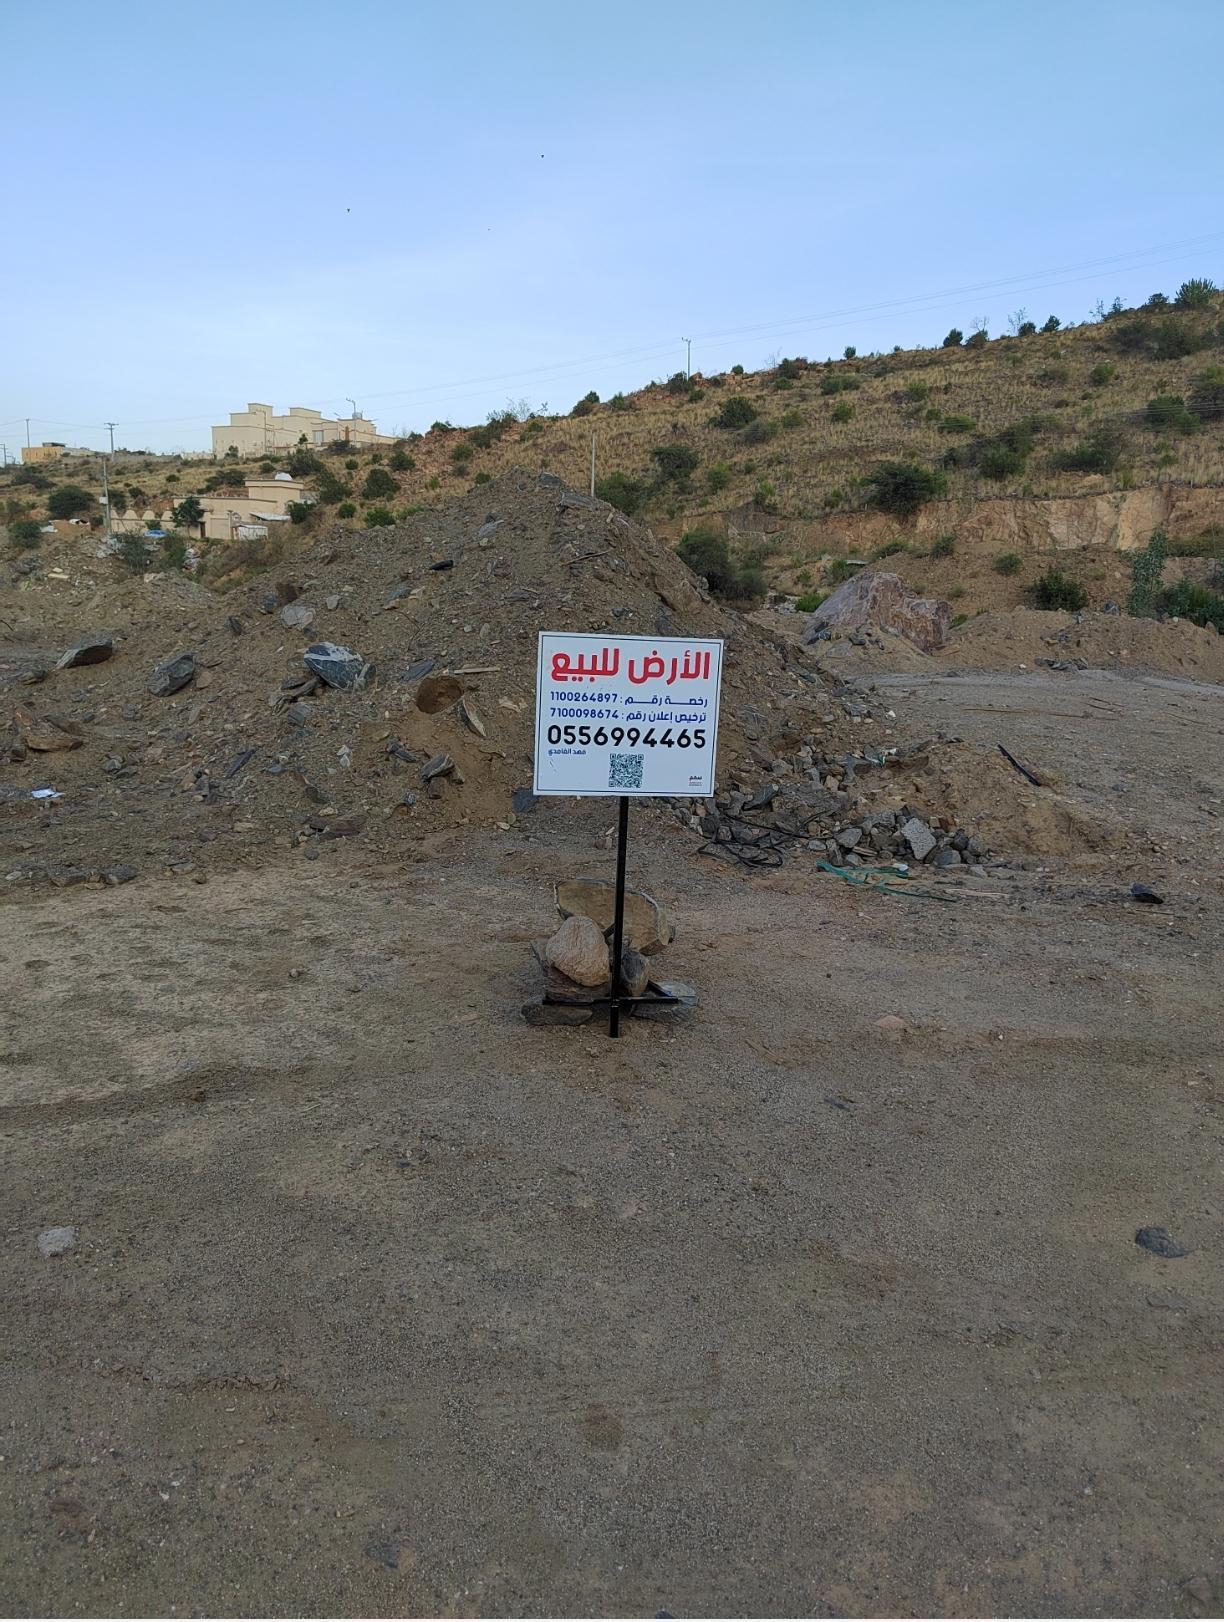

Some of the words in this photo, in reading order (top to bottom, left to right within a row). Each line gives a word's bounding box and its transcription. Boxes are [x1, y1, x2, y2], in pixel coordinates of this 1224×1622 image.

[551, 647, 620, 683] للبيع
[628, 648, 711, 685] الأرض
[550, 691, 618, 703] 1100264897
[665, 696, 708, 708] رخصة
[550, 707, 619, 719] 7100098674
[648, 710, 672, 723] إعلان
[675, 712, 706, 723] ترخيص
[547, 725, 706, 748] 0556994465
